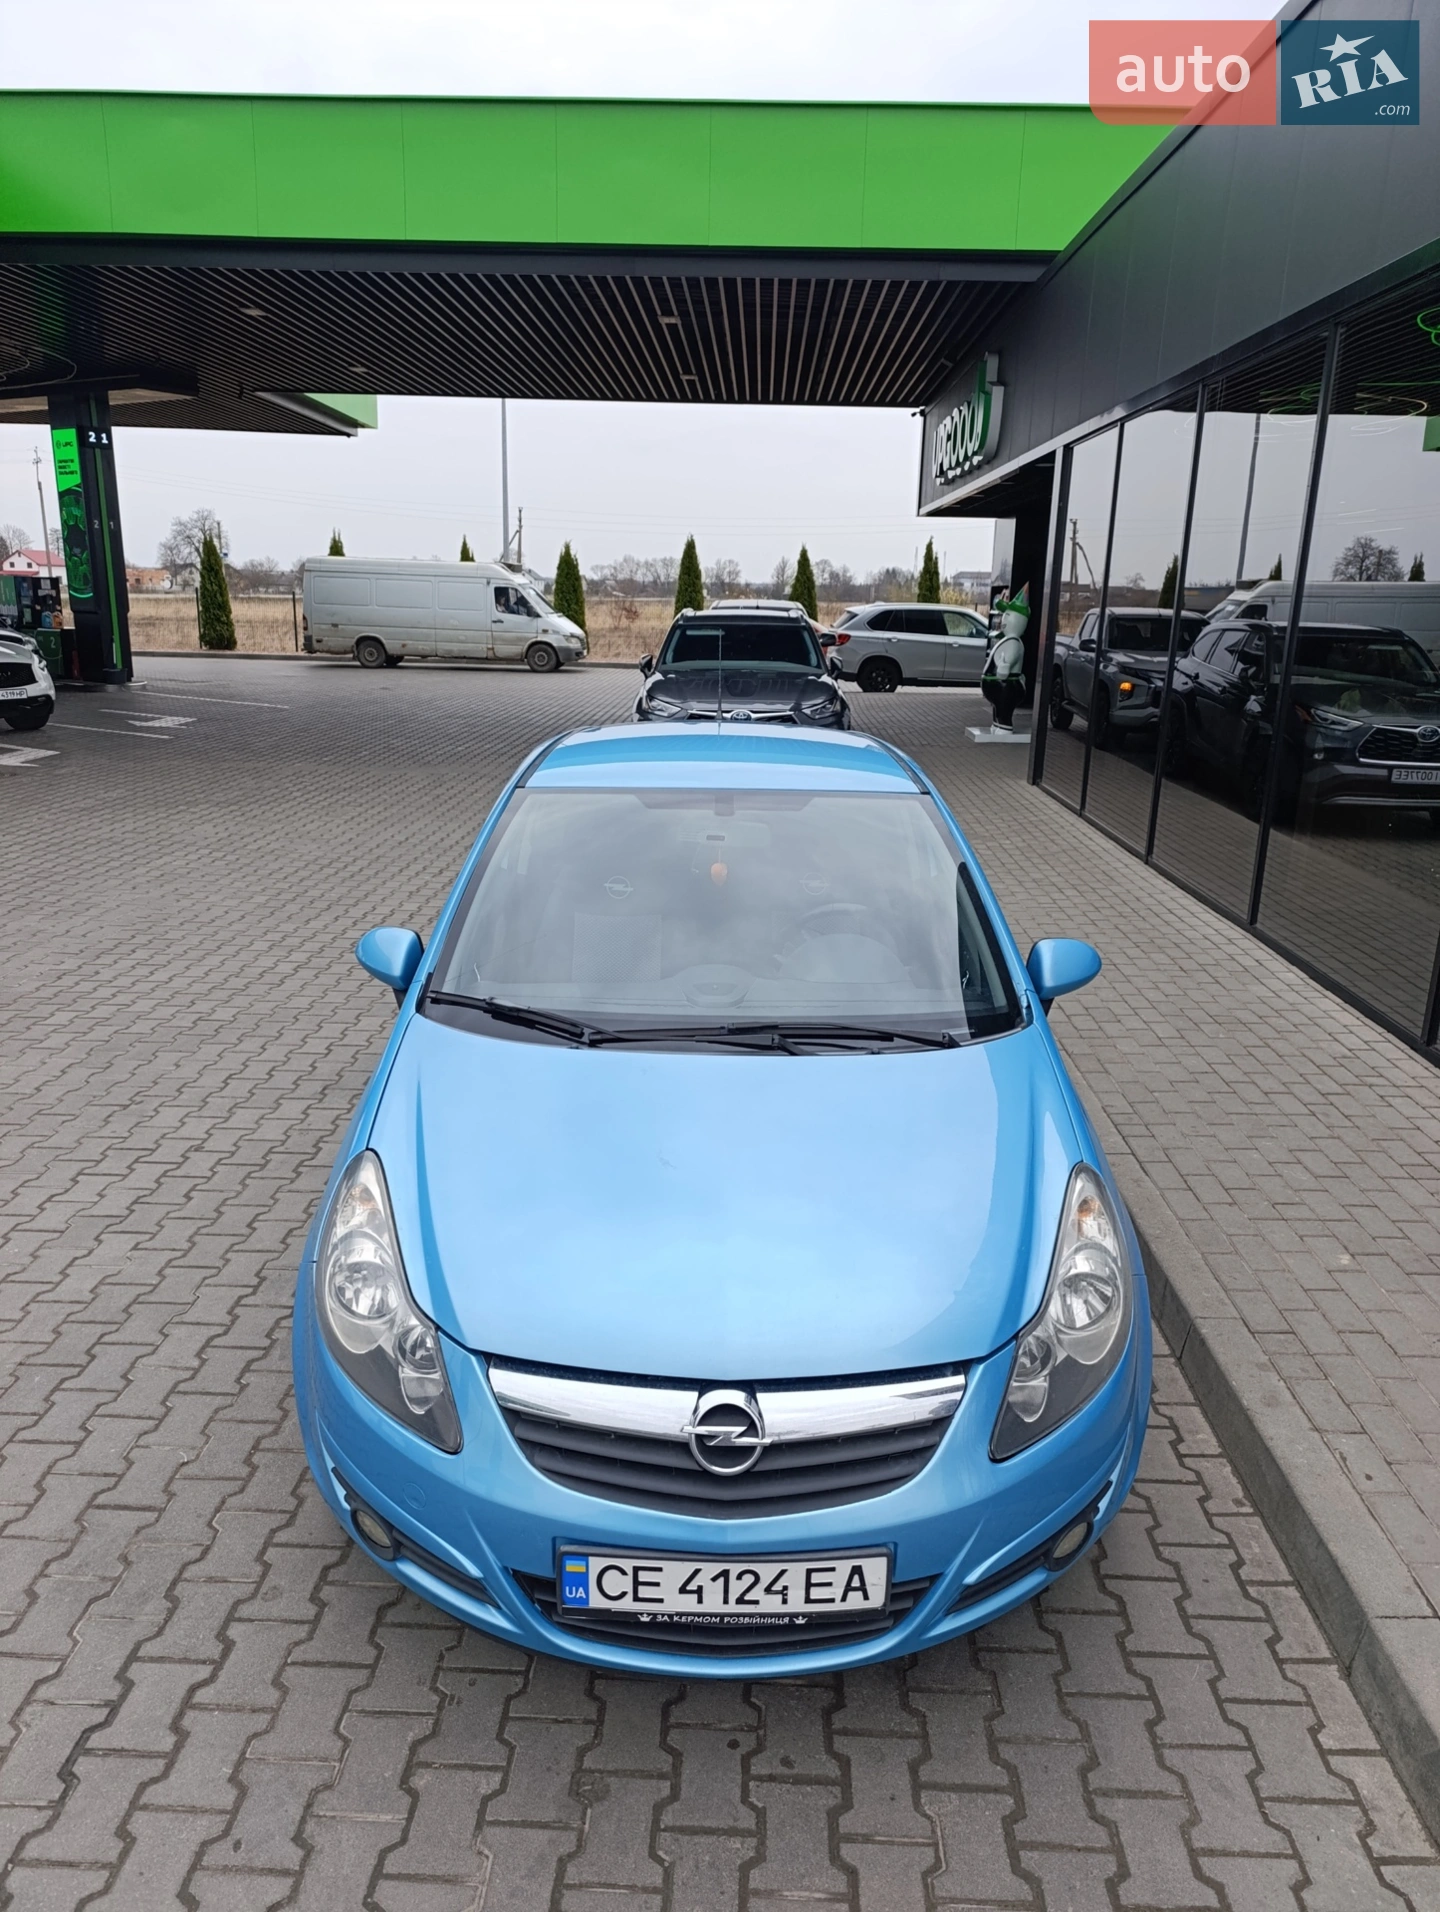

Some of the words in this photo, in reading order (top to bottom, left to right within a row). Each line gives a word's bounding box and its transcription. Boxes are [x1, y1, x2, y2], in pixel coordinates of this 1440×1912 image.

[88, 431, 97, 443] 2
[101, 432, 109, 444] 1
[93, 519, 100, 529] 2
[109, 521, 114, 530] 1
[50, 637, 56, 649] 2
[596, 1563, 665, 1604] CE
[678, 1567, 789, 1606] 4124
[803, 1564, 870, 1605] EA
[565, 1586, 587, 1599] UA
[655, 1614, 670, 1622] ЗА
[673, 1615, 720, 1624] КЕРМОМ
[723, 1615, 790, 1625] РОЗБІЙНИЦЯ
